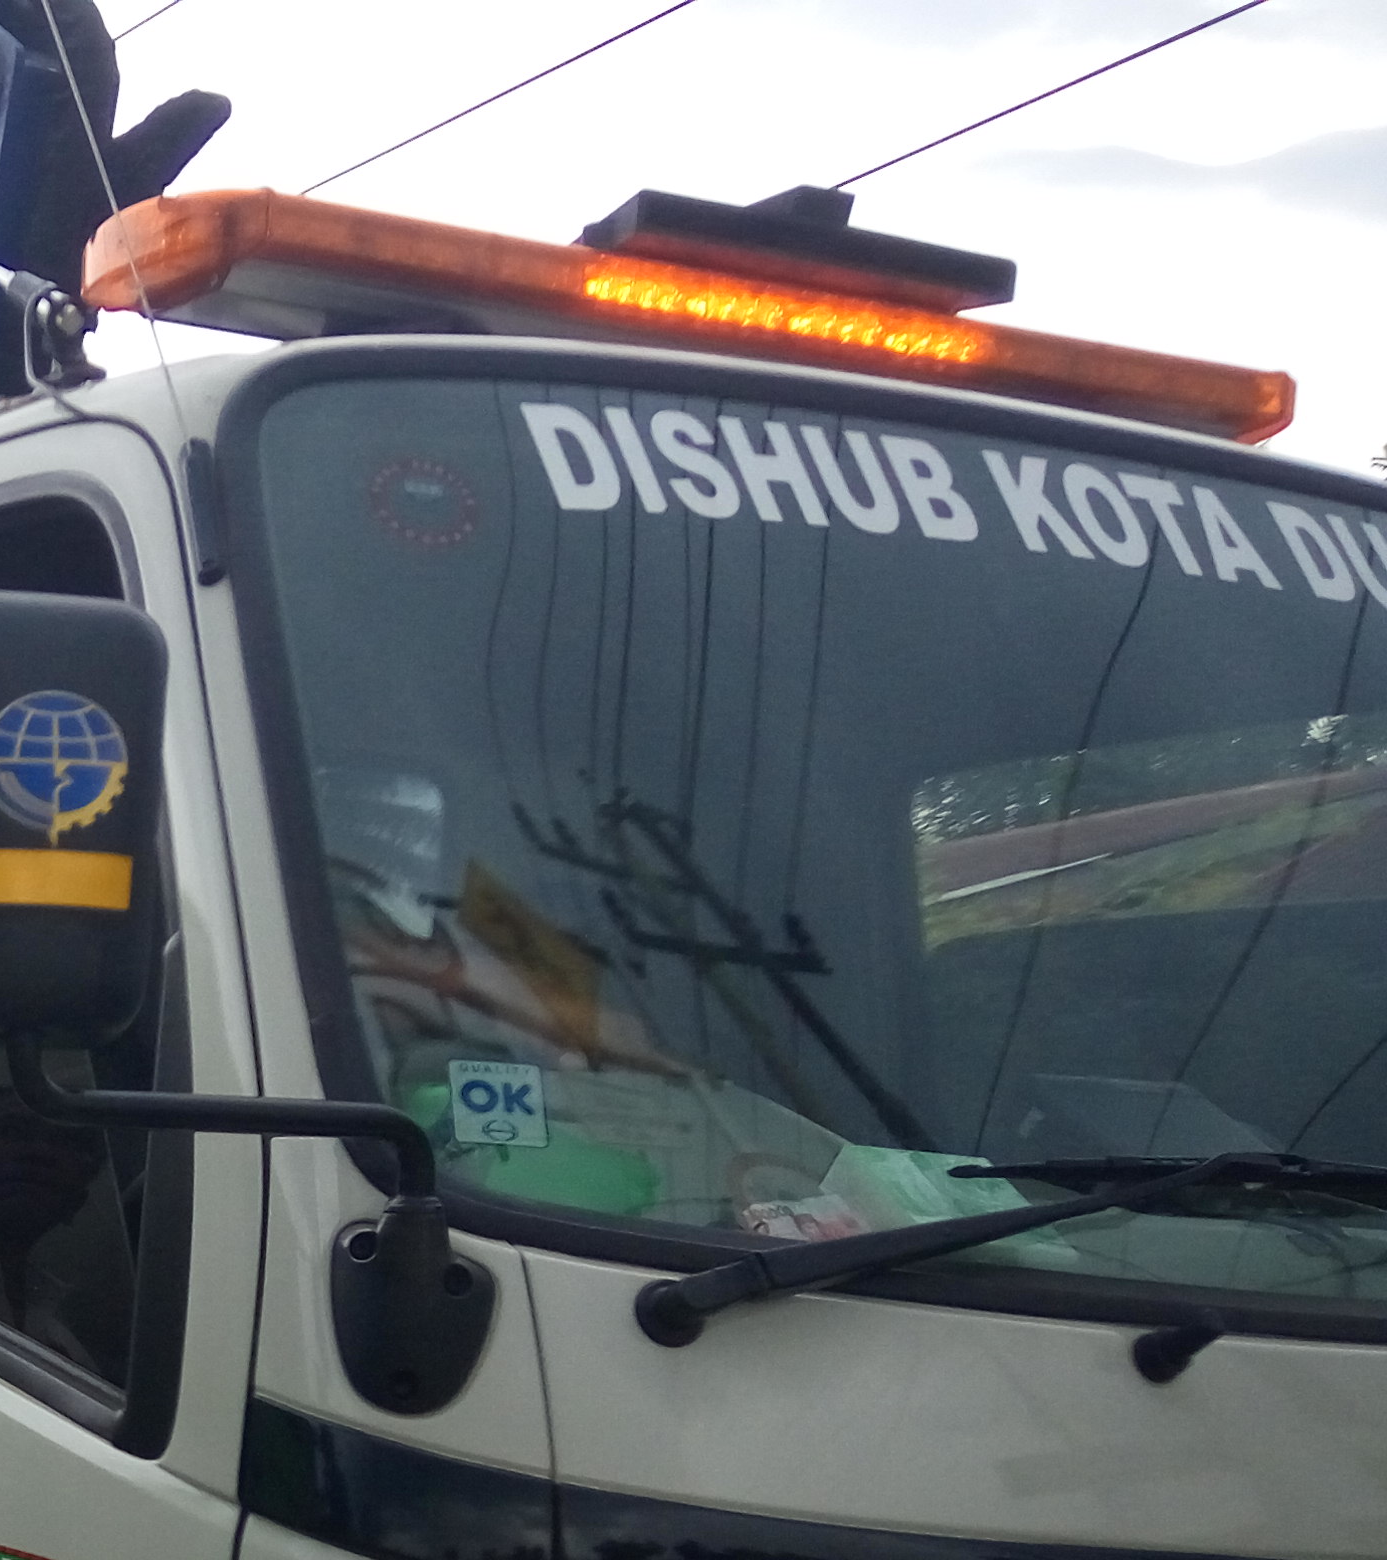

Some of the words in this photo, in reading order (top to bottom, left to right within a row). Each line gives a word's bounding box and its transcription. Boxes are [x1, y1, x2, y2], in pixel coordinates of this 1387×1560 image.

[520, 402, 979, 542] DISHUB
[983, 448, 1283, 591] KOTA
[459, 1063, 531, 1075] QUALITY
[461, 1080, 535, 1115] OK
